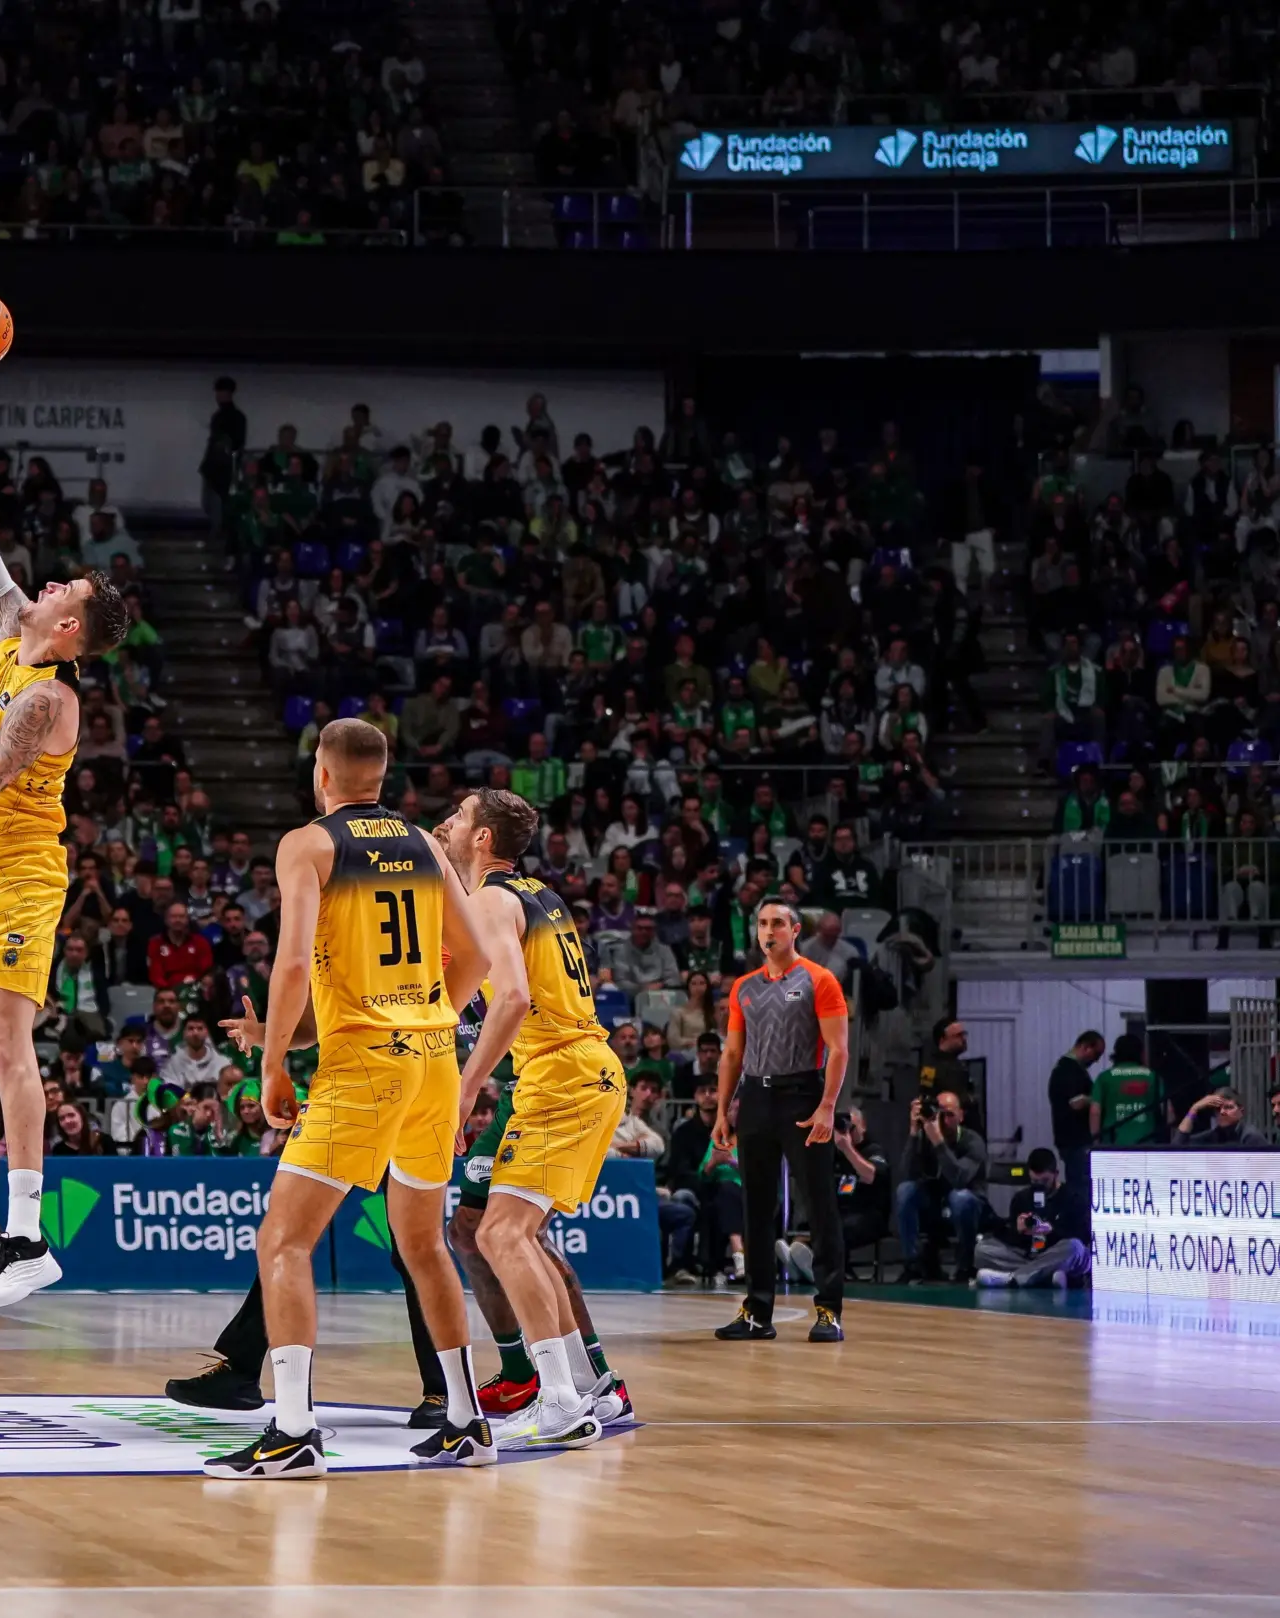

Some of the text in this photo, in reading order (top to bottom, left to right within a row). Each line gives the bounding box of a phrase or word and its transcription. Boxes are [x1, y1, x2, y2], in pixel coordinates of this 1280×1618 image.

[727, 131, 829, 156] Fundación
[922, 128, 1026, 153] Fundación
[1123, 124, 1228, 149] Fundación
[727, 152, 801, 175] Unicaja
[922, 149, 998, 172] Unicaja
[1123, 145, 1199, 168] Unicaja
[32, 403, 125, 430] CARPENA
[346, 818, 409, 838] GIEDRAITIS
[374, 889, 422, 967] 31
[397, 982, 423, 991] IBERIA
[361, 991, 425, 1009] EXPRESS
[425, 1027, 455, 1050] CICA
[115, 1218, 256, 1259] Unicaja
[1106, 1231, 1163, 1271] MARIA,
[1170, 1234, 1241, 1276] RONDA,
[1248, 1237, 1280, 1276] RO
